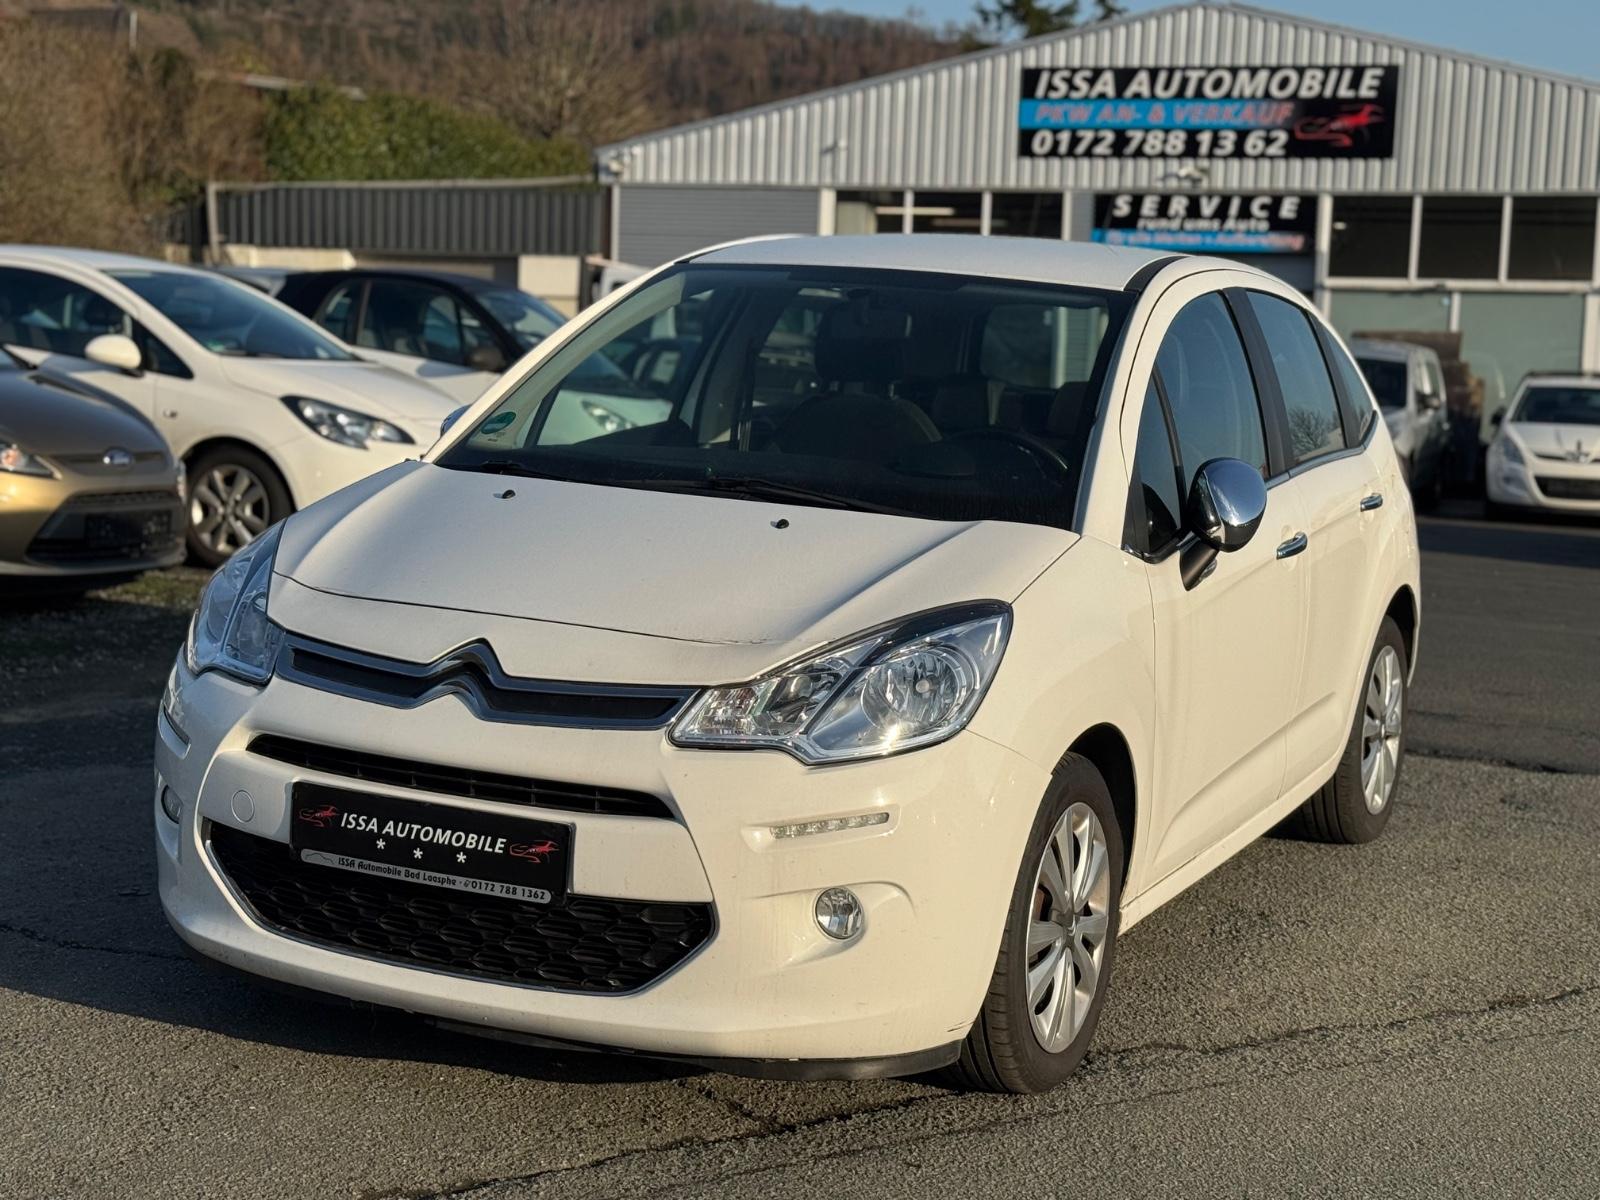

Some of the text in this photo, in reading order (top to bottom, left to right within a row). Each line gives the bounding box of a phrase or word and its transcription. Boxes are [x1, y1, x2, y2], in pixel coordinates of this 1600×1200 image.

[1034, 68, 1384, 100] ISSA AUTOMOBILE
[1034, 103, 1294, 124] PKW AN- & VERKAUF
[1031, 128, 1289, 156] 0172 788 13 62
[1112, 194, 1301, 219] SERVICE
[340, 812, 507, 853] ISSA AUTOMOBILE
[338, 857, 356, 868] ISSA
[357, 860, 402, 877] Automobile
[404, 868, 421, 880] Bad
[471, 880, 496, 893] 0172
[499, 884, 518, 896] 788
[521, 888, 546, 901] 1362
